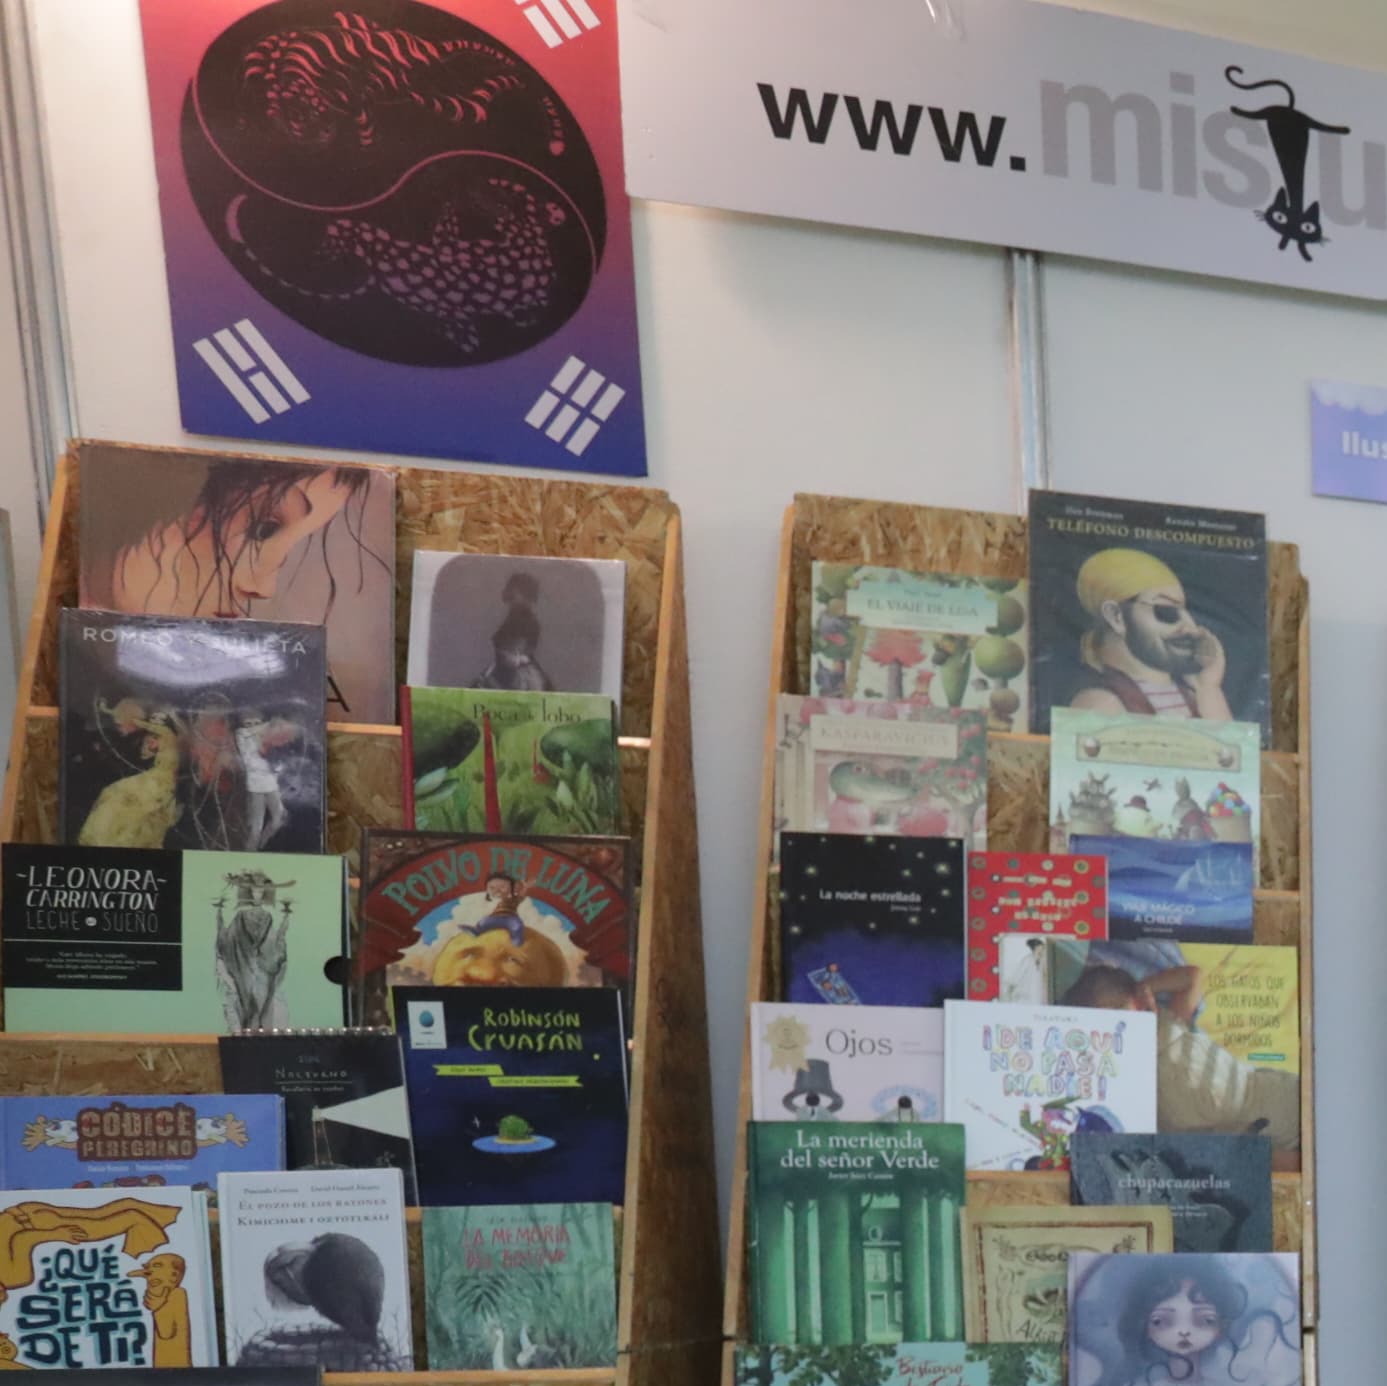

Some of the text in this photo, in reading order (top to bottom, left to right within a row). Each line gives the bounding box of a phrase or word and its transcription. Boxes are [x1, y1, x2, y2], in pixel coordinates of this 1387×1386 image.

[1048, 517, 1255, 550] TELÉFONO DESCOMPUESTO
[83, 627, 173, 647] ROMEO
[542, 698, 583, 723] lobo
[29, 866, 159, 890] LEONORA
[382, 848, 611, 924] POLVO DE LUNA
[27, 889, 158, 910] CARRINGTON
[819, 890, 832, 901] La
[835, 890, 867, 902] noche
[27, 910, 80, 930] LECHE
[825, 1027, 894, 1058] Ojos
[797, 1128, 924, 1149] La merienda
[780, 1148, 939, 1170] del señor Verde
[1118, 1173, 1232, 1193] chupacazuelas
[493, 1226, 570, 1245] MEMORIA
[39, 1244, 120, 1292] ¿QUÉ
[17, 1280, 142, 1329] SERÁ
[19, 1322, 147, 1368] DE TI?
